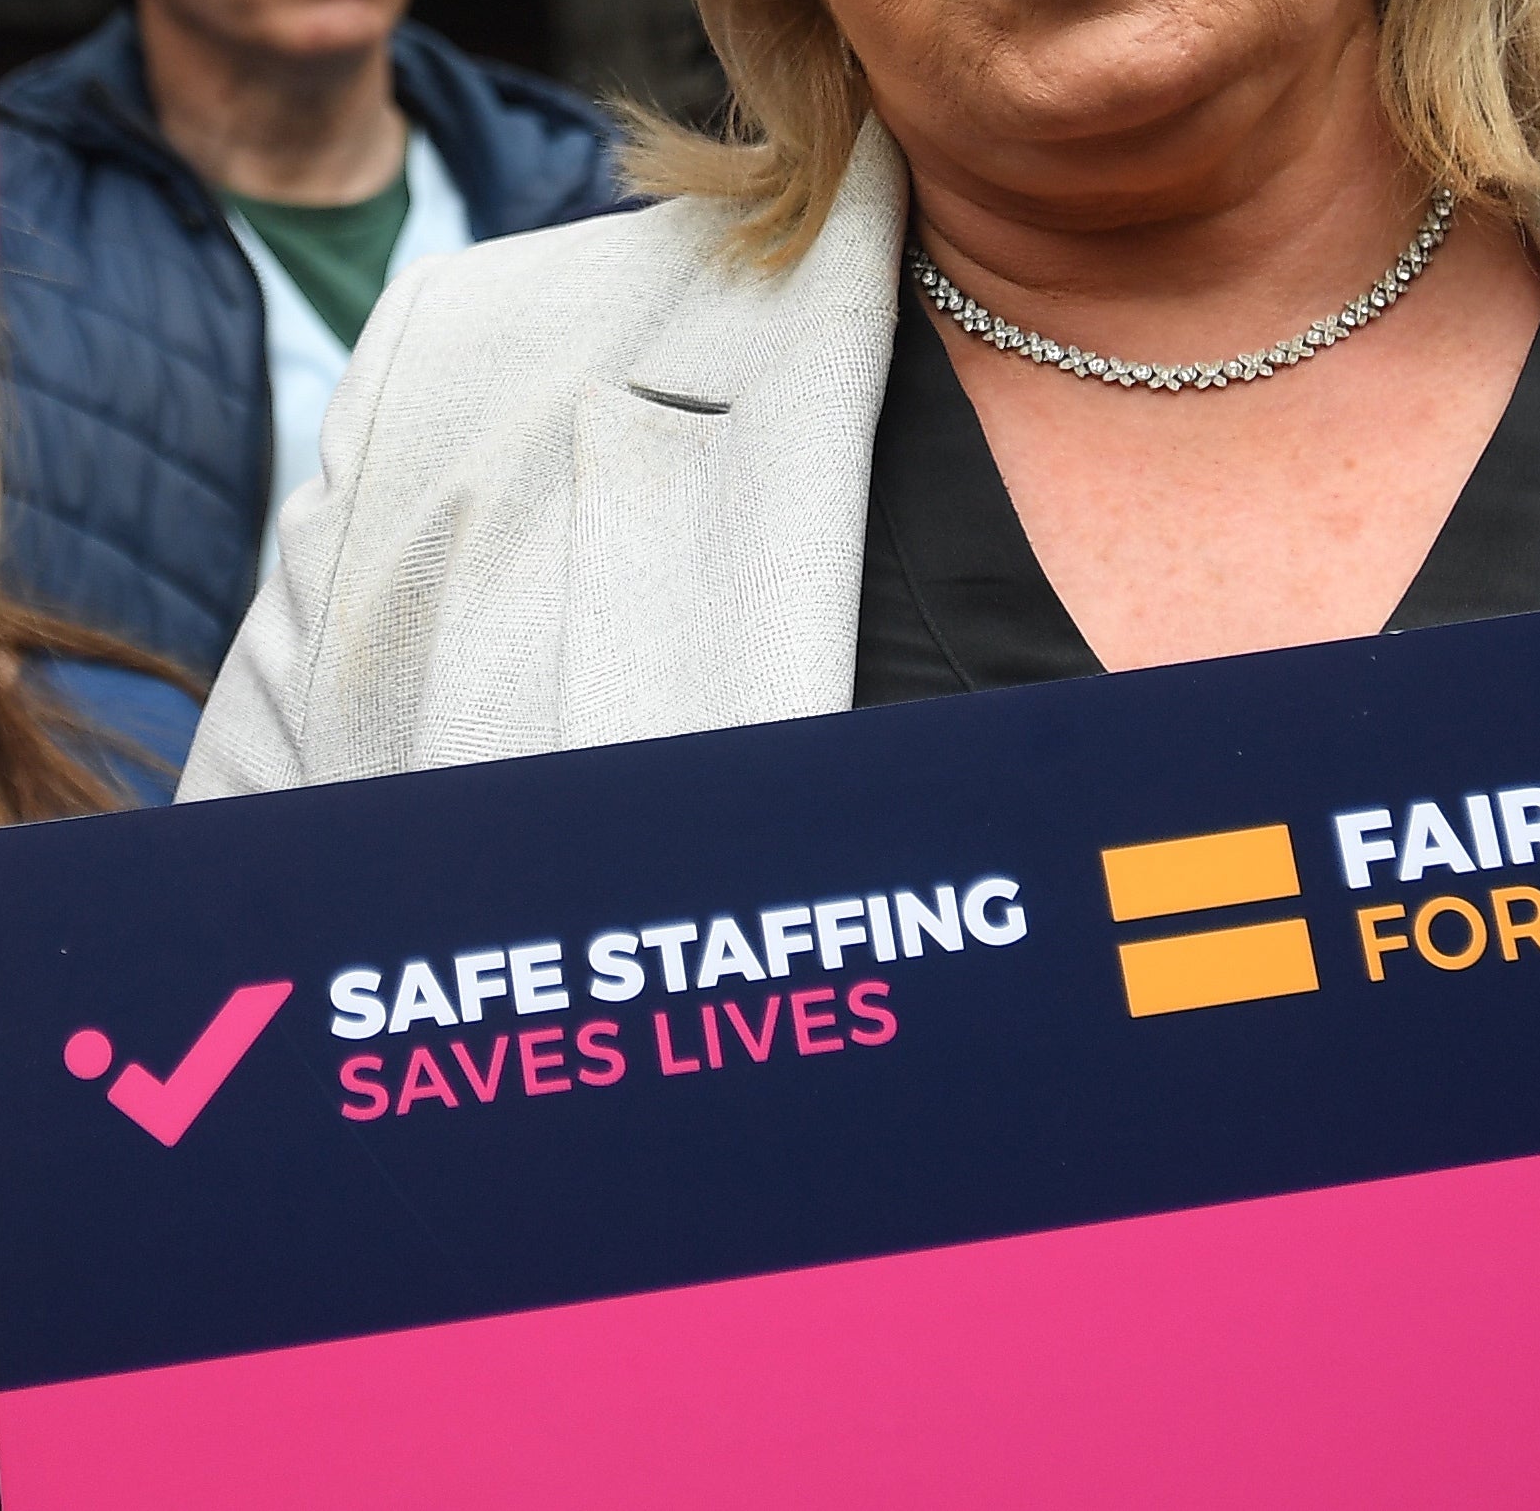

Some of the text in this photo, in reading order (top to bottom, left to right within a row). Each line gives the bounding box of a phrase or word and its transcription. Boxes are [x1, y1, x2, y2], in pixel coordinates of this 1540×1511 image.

[328, 875, 1030, 1043] SAFE STAFFING
[337, 978, 901, 1123] SAVES LIVES
